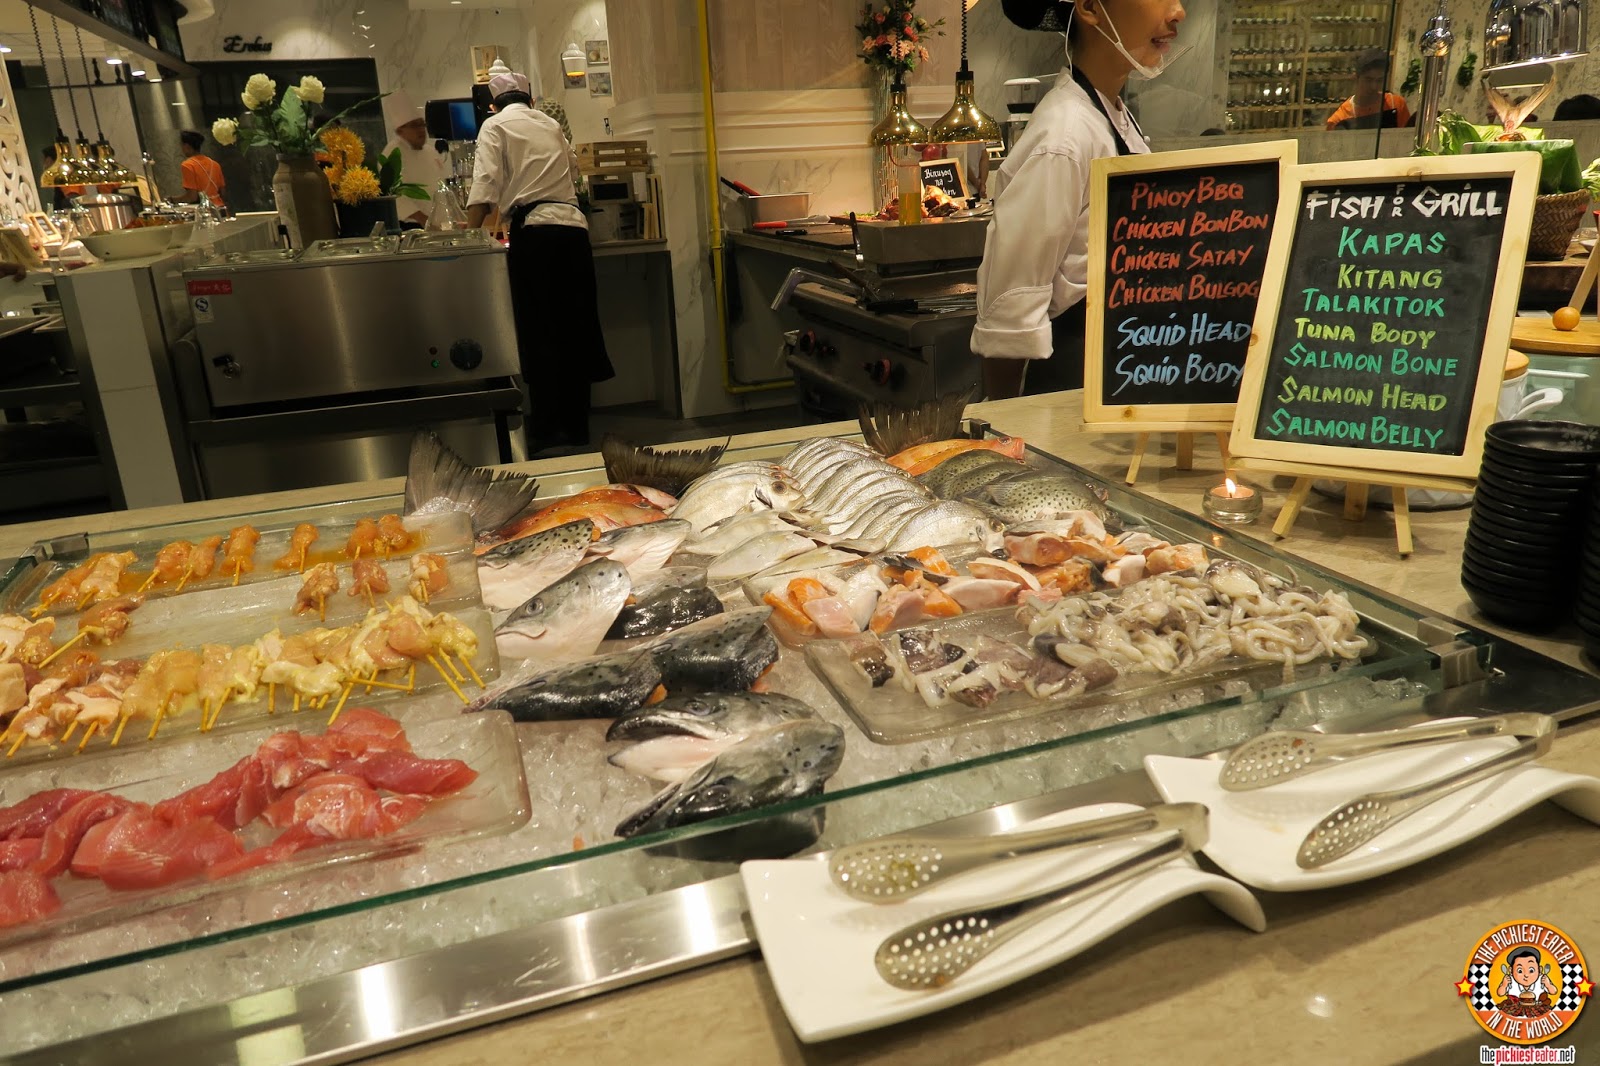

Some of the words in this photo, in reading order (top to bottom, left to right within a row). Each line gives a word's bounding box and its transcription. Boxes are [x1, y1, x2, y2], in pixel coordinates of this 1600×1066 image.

[1131, 182, 1196, 210] PINOY
[1197, 176, 1244, 204] BBQ
[1306, 189, 1385, 220] FISH
[1411, 182, 1503, 218] GRILL
[1112, 215, 1185, 242] CHICKEN
[1189, 209, 1268, 237] BONBON
[1337, 225, 1446, 258] KAPAS
[1111, 245, 1180, 275] CHICKEN
[1186, 241, 1254, 270] SATAY
[1108, 276, 1184, 309] CHICKEN
[1188, 273, 1260, 301] BULGOG
[1337, 263, 1444, 290] KITANG
[1302, 287, 1445, 318] TALAKITOK
[1116, 312, 1186, 349] SQUID
[1189, 312, 1251, 346] HEAD
[1294, 317, 1355, 343] TUNA
[1370, 322, 1436, 350] BODY
[1111, 354, 1180, 397] SQUID
[1184, 353, 1245, 387] BODY
[1283, 342, 1382, 374] SALMON
[1391, 348, 1458, 376] BONE
[1277, 375, 1373, 406] SALMON
[1381, 382, 1447, 411] HEAD
[1266, 407, 1366, 440] SALMON
[1371, 416, 1444, 448] BELLY
